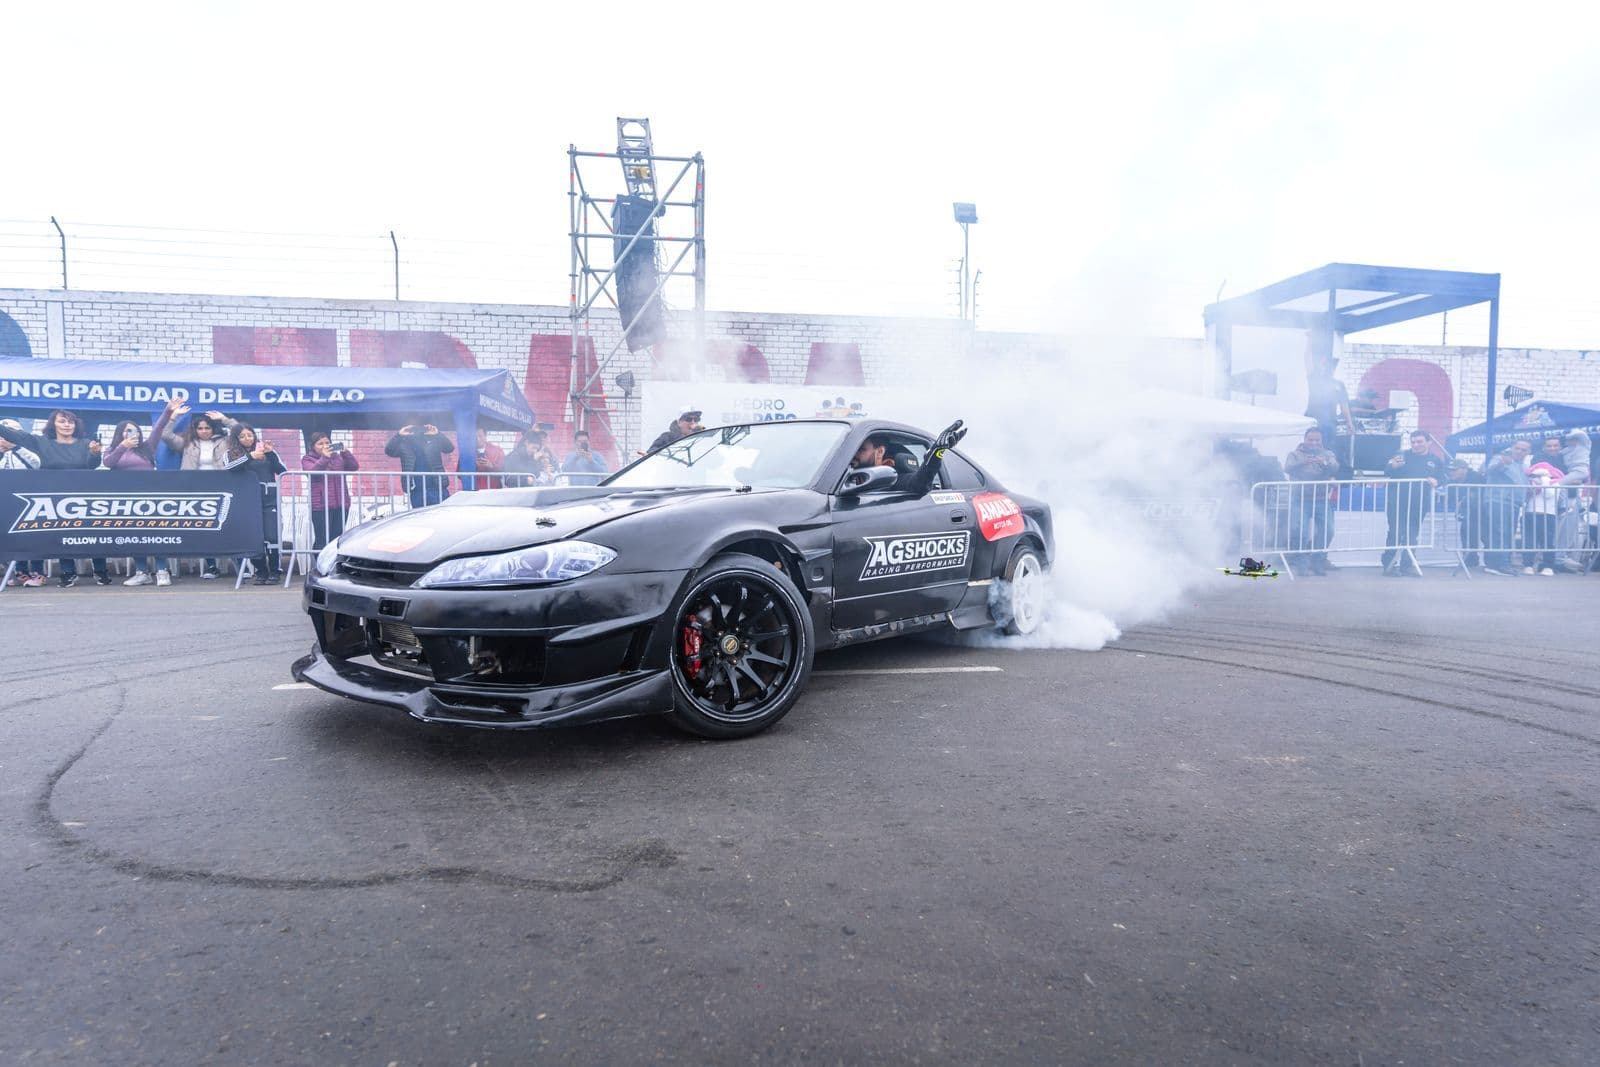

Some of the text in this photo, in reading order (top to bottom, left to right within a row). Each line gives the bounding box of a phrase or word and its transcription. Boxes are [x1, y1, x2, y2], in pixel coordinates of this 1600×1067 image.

[199, 388, 250, 403] DEL
[259, 388, 365, 403] CALLAO
[734, 399, 785, 410] PEDRO
[1459, 431, 1540, 447] MUNIIPALIDAD
[18, 519, 215, 530] RACING PERFORMANCE
[62, 536, 182, 545] FOLLOW US @AG.SHOCKS
[864, 557, 963, 577] RACING PERFORMANCE
